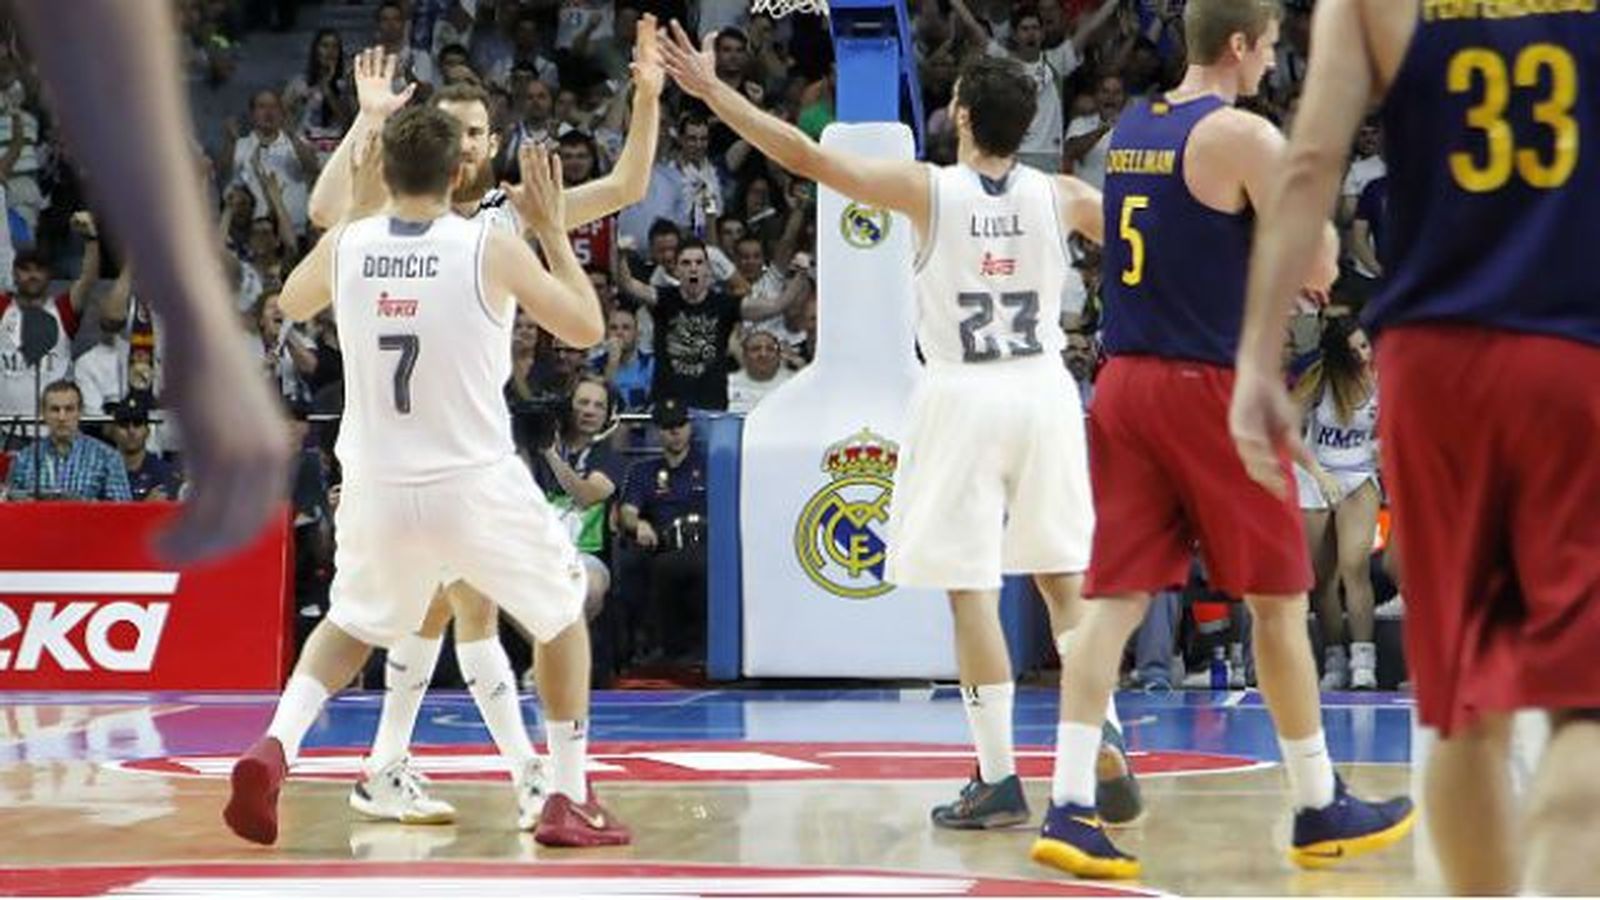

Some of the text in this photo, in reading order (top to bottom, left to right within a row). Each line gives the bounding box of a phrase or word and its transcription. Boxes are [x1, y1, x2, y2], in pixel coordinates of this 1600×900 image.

[1447, 43, 1579, 193] 33
[1119, 196, 1149, 286] 5
[957, 291, 1043, 364] 23
[378, 334, 419, 414] 7
